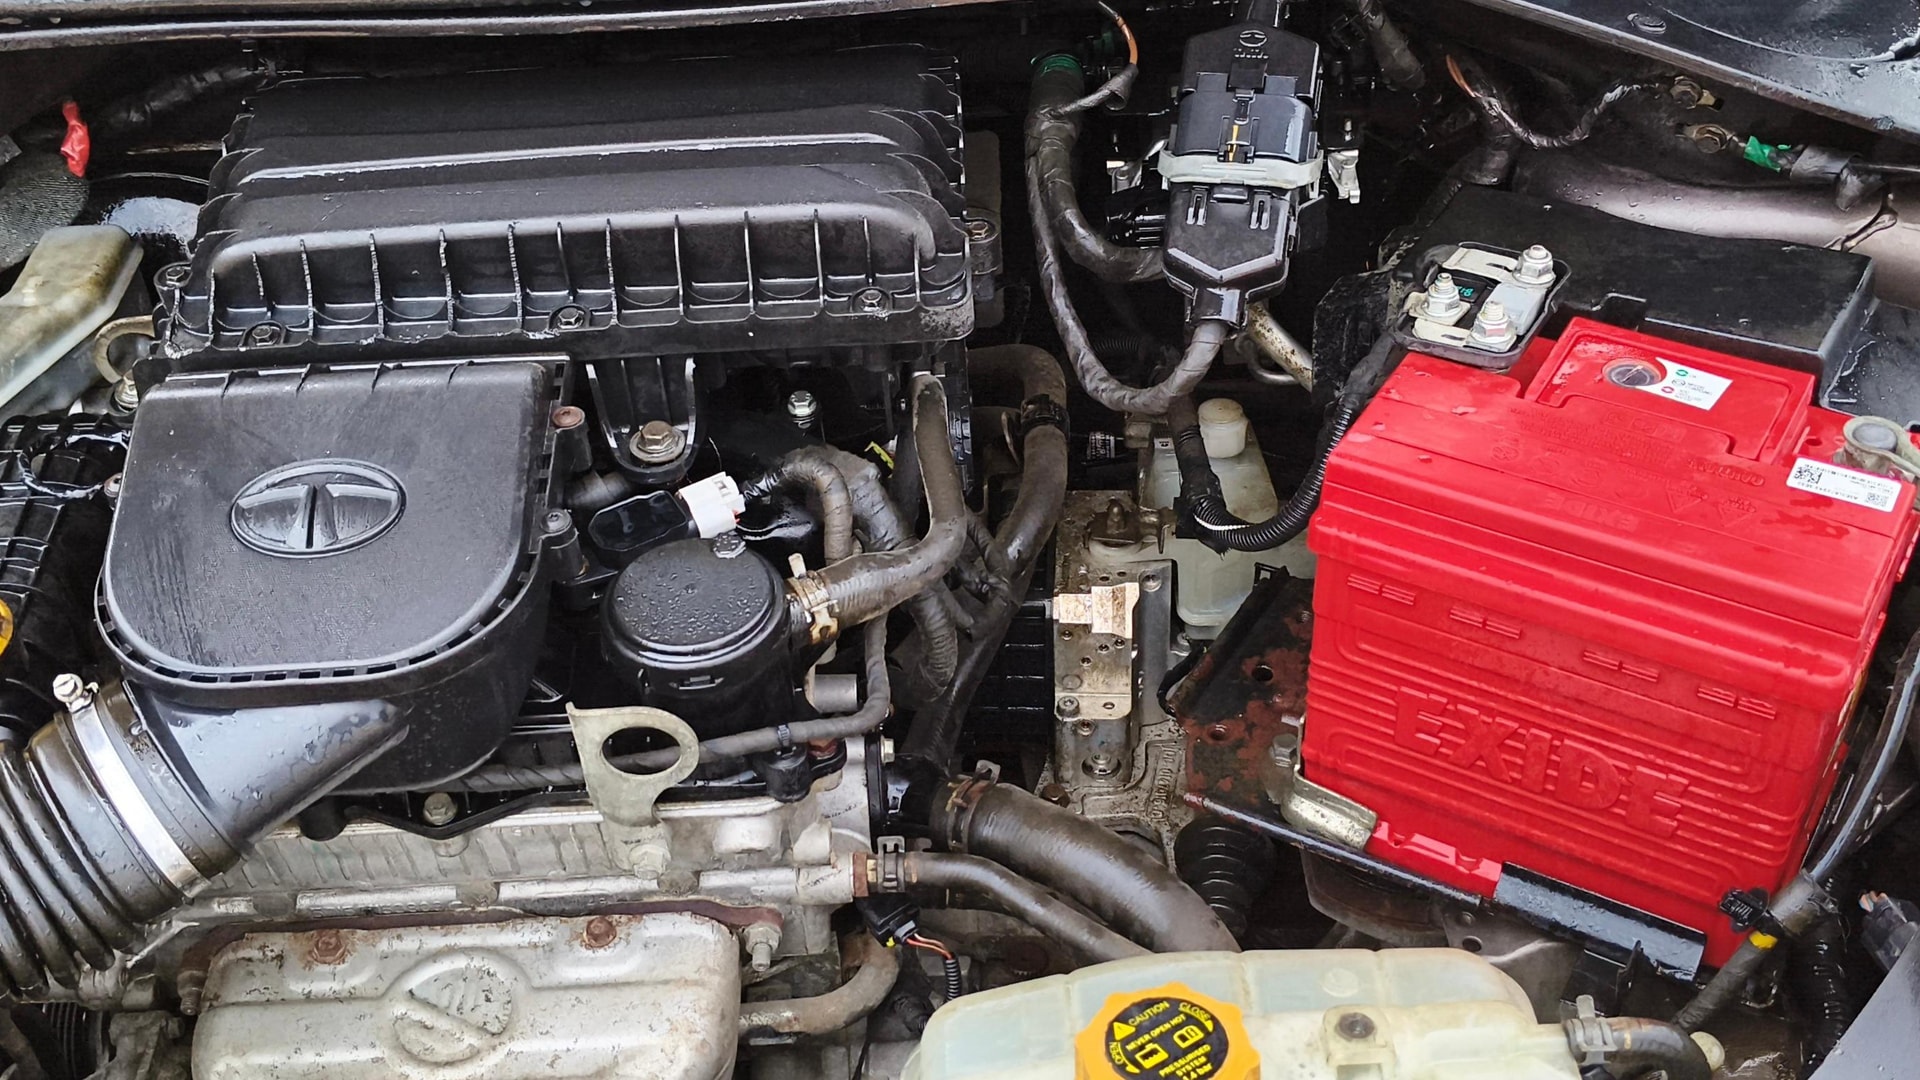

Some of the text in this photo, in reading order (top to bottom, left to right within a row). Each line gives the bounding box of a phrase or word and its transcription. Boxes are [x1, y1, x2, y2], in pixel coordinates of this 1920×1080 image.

[1546, 492, 1639, 532] EXIDE
[1394, 686, 1689, 838] EXIDE
[1128, 1001, 1170, 1026] CAUTION
[1180, 1002, 1211, 1022] CLOSE
[1126, 1014, 1186, 1051] NEVER OPEN HOT
[1109, 1041, 1123, 1064] OPEN
[1176, 1056, 1206, 1076] SYSTEM
[1196, 1063, 1212, 1075] bar
